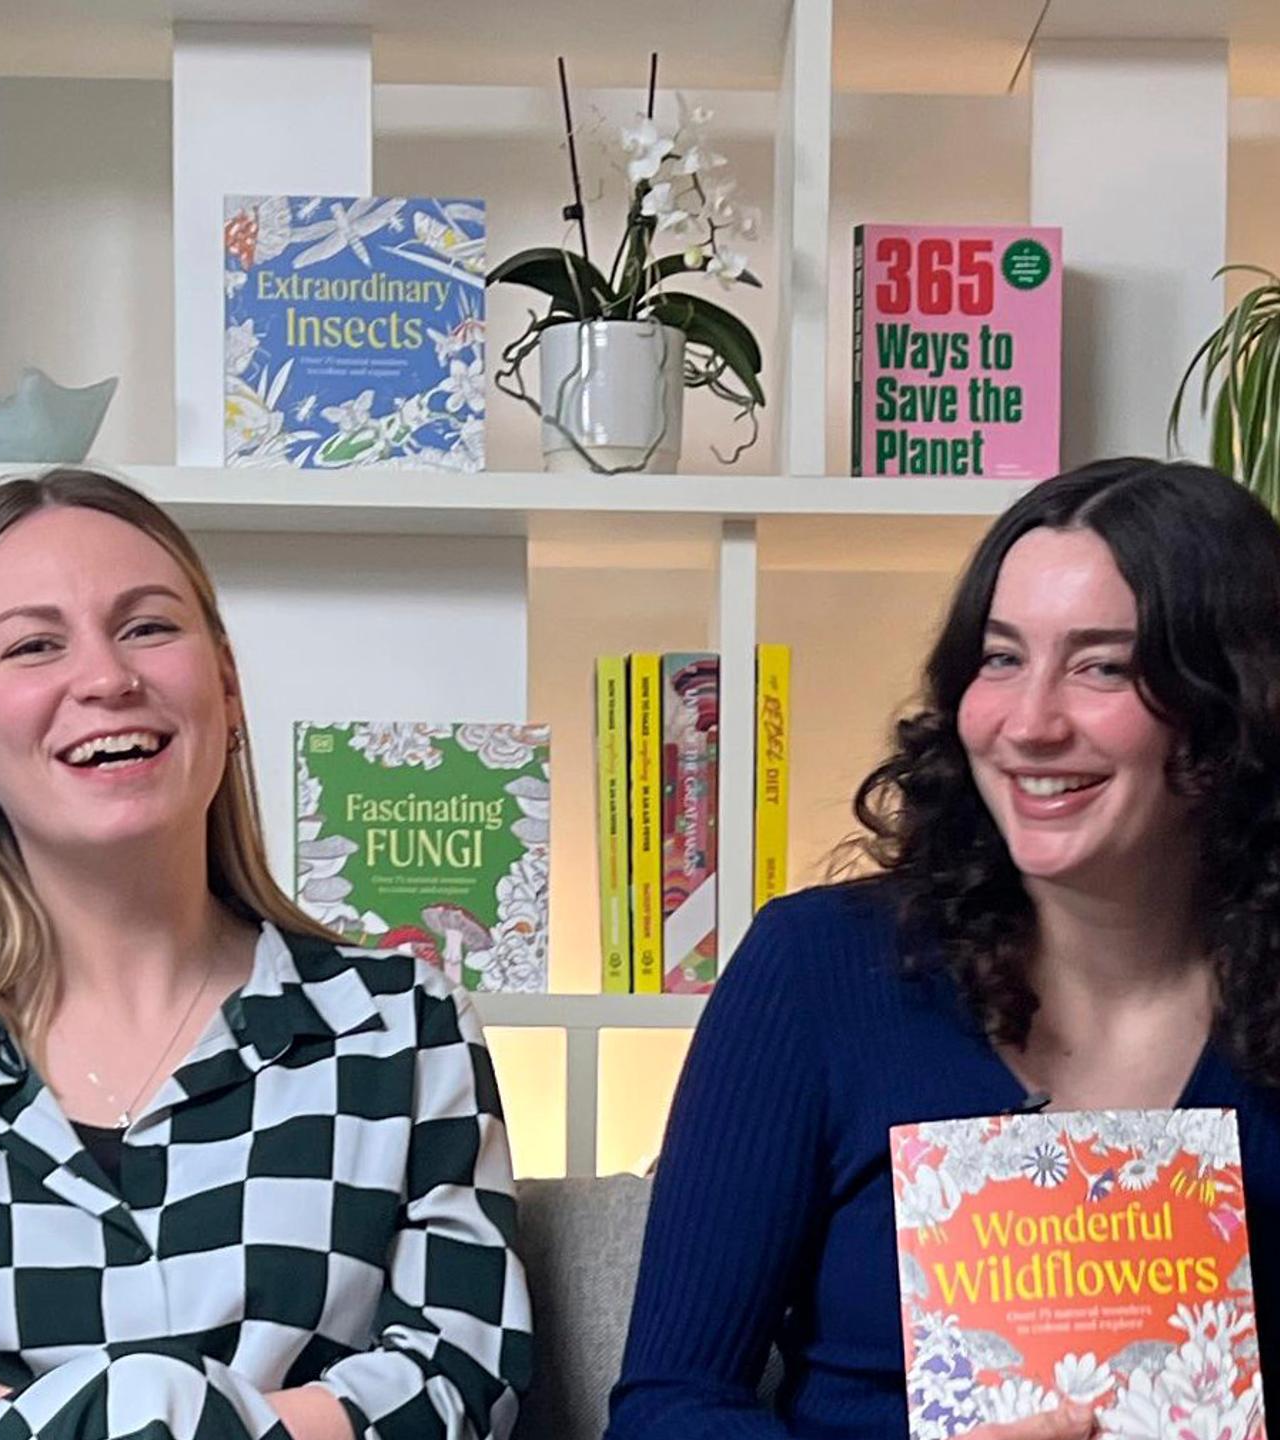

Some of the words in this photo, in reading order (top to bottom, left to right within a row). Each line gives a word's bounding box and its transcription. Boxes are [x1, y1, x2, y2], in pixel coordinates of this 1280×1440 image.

[256, 270, 451, 312] Extraordinary
[875, 237, 994, 316] 365
[285, 307, 423, 350] Insects
[875, 322, 970, 379] Ways
[979, 324, 1013, 371] to
[875, 376, 959, 423] Save
[968, 377, 1023, 423] the
[875, 428, 984, 476] Planet
[765, 768, 780, 804] DIET
[345, 793, 505, 830] Fascinating
[366, 829, 483, 868] FUNGI
[971, 1200, 1173, 1249] Wonderful
[933, 1249, 1220, 1307] Wildflowers
